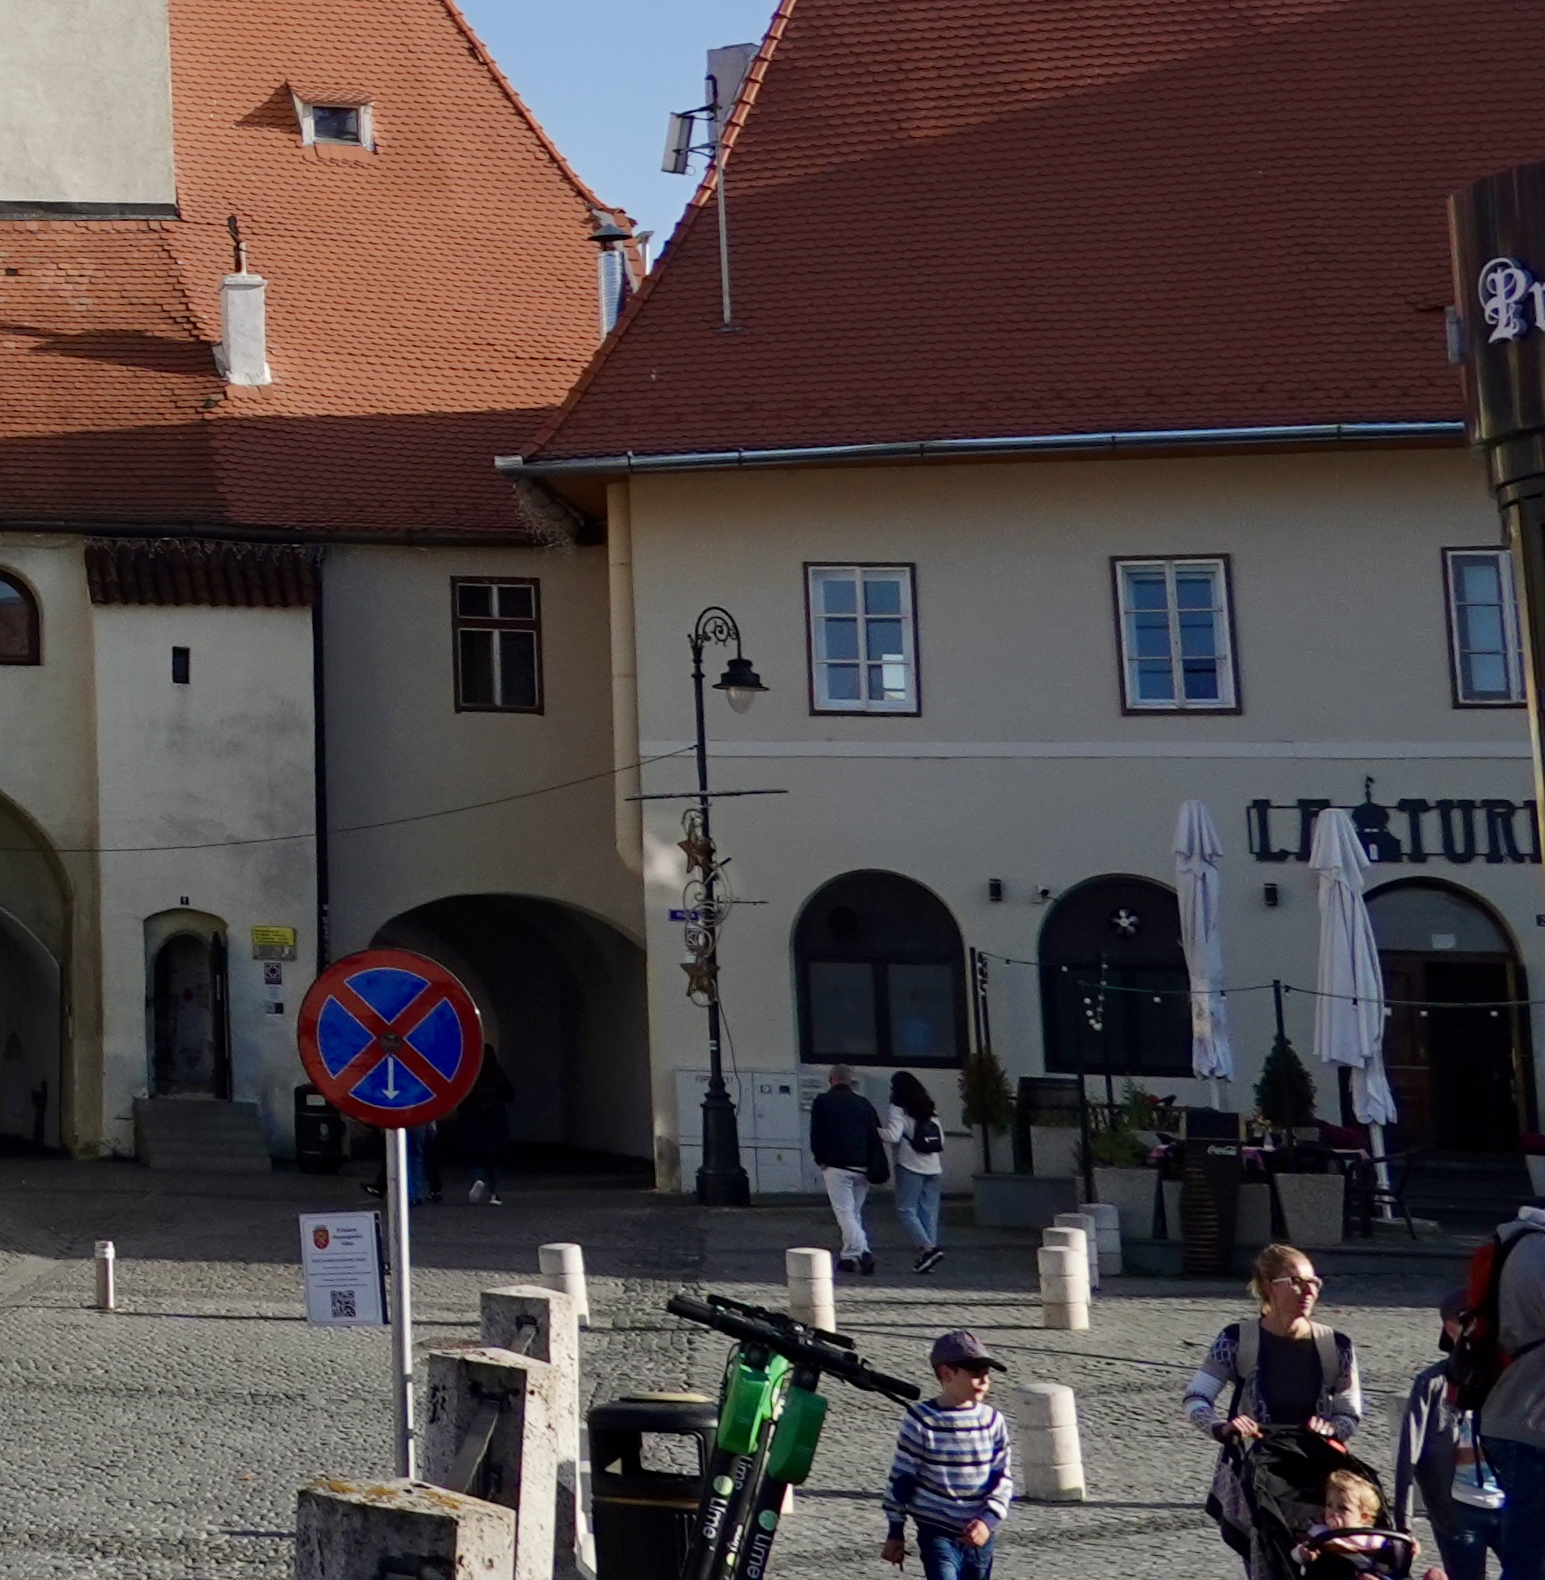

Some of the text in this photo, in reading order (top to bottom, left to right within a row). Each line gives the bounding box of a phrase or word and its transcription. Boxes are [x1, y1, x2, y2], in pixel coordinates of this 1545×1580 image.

[735, 1455, 754, 1490] Lime
[702, 1497, 729, 1539] Lime
[747, 1533, 772, 1579] Lime
